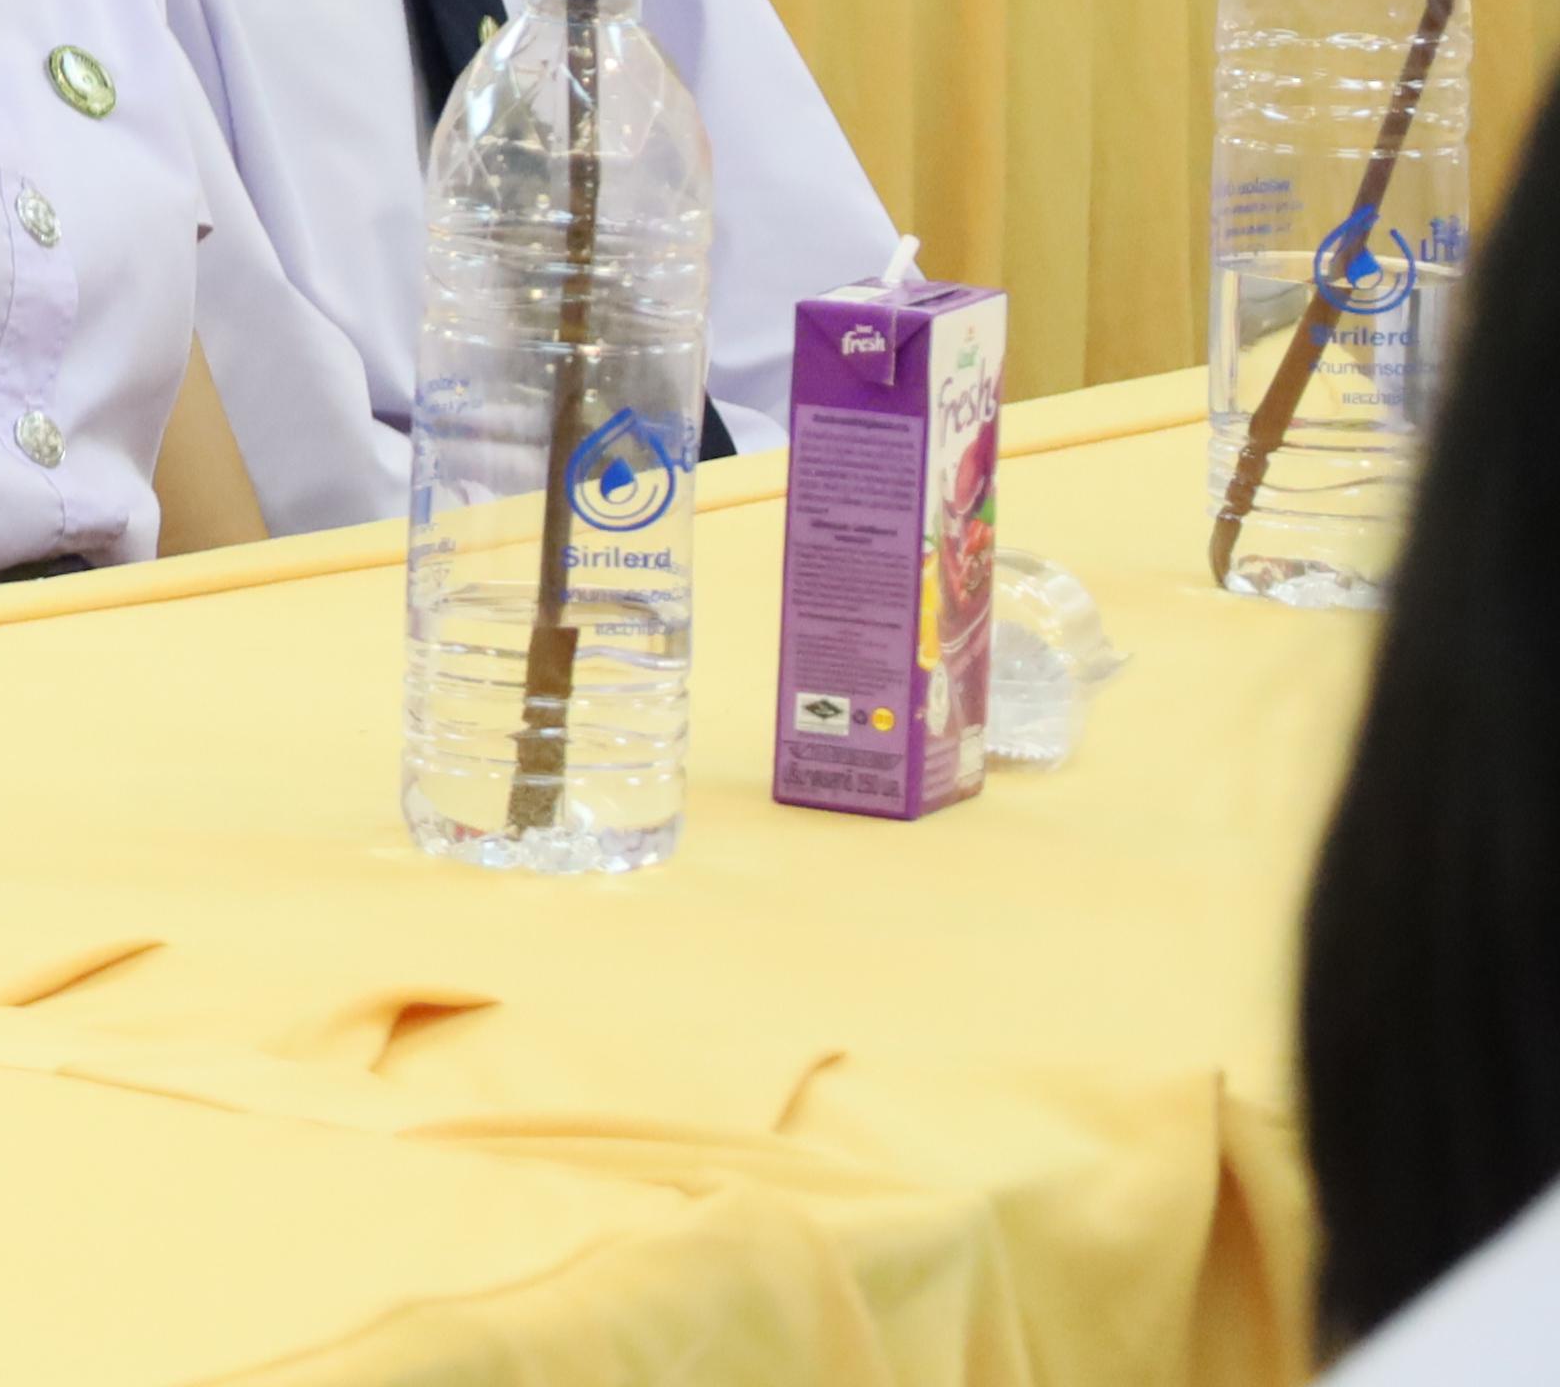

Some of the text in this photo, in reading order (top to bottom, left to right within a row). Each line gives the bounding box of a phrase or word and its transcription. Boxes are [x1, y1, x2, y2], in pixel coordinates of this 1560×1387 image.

[840, 330, 887, 356] fresh
[937, 358, 998, 445] fresh
[561, 545, 672, 570] Sirilerd
